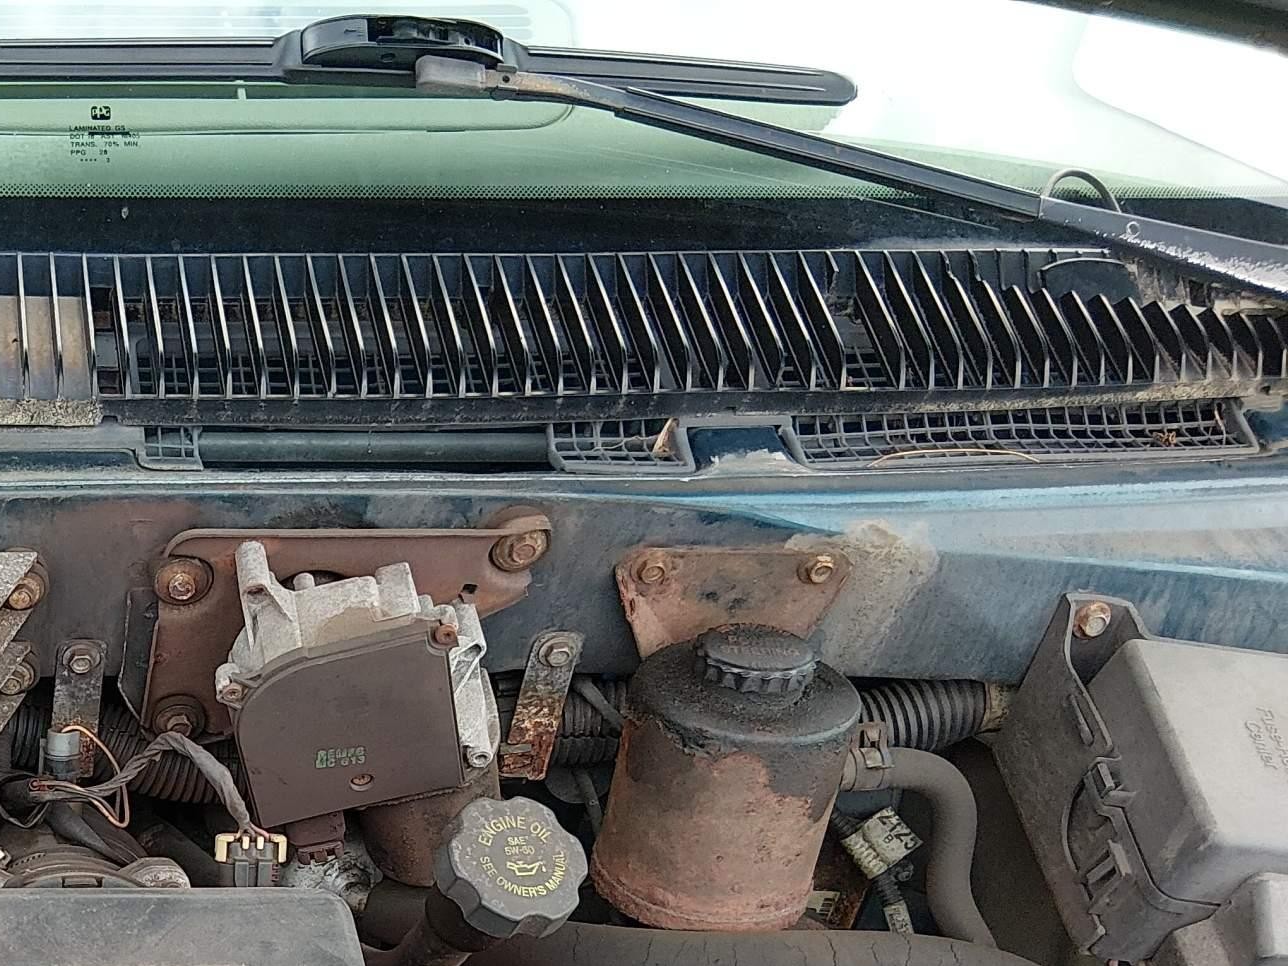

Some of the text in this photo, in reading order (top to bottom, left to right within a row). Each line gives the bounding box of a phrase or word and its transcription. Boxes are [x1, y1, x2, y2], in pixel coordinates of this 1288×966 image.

[90, 105, 112, 120] PPG
[478, 816, 553, 847] ENGINE OIL
[882, 833, 894, 844] B
[507, 836, 527, 846] SAE
[479, 850, 569, 898] SEE OWNER'S MANUAL
